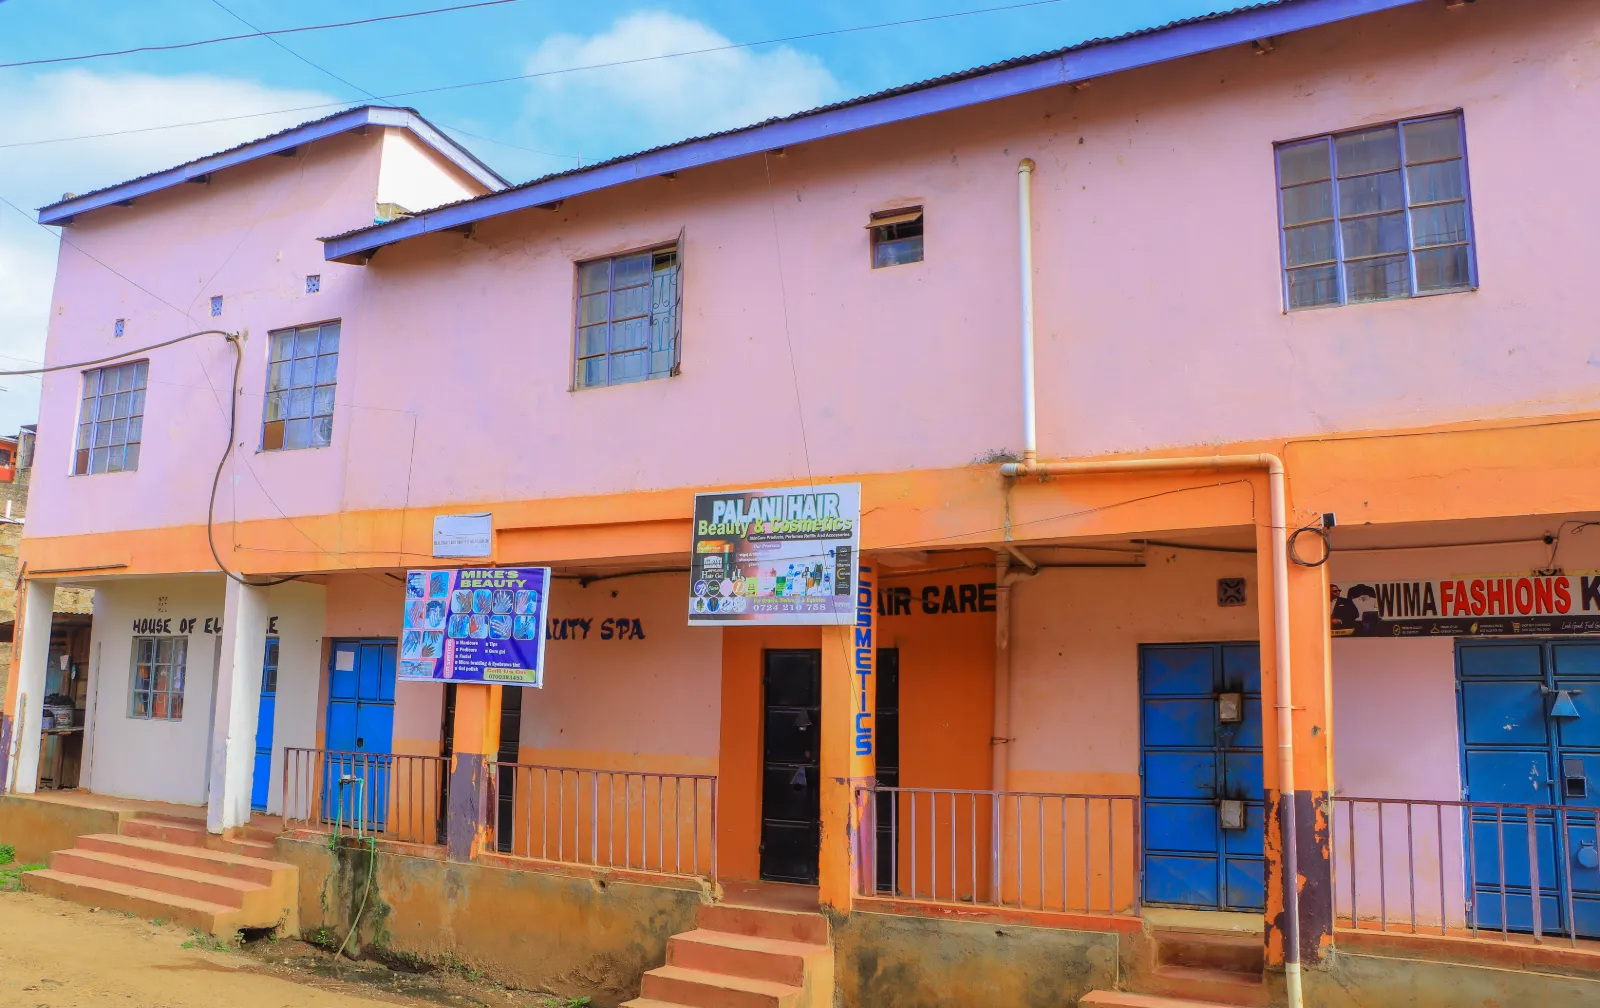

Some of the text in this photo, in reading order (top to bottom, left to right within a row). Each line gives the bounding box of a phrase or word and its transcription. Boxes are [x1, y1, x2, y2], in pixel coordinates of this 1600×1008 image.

[712, 493, 840, 524] PALANI HAIR
[698, 513, 853, 539] Beauty & Cosmetics
[460, 579, 527, 588] BEAUTY
[461, 570, 519, 579] MIKE'S
[701, 570, 714, 579] Hair
[753, 603, 779, 611] 0724
[782, 603, 802, 611] 210
[806, 603, 826, 611] 758
[922, 583, 996, 615] CARE
[1375, 582, 1438, 617] WIMA
[1440, 576, 1571, 616] FASHIONS
[133, 618, 171, 634] HOUSE
[179, 617, 197, 634] OF
[600, 617, 646, 640] SPA
[855, 566, 872, 756] COSMETICS
